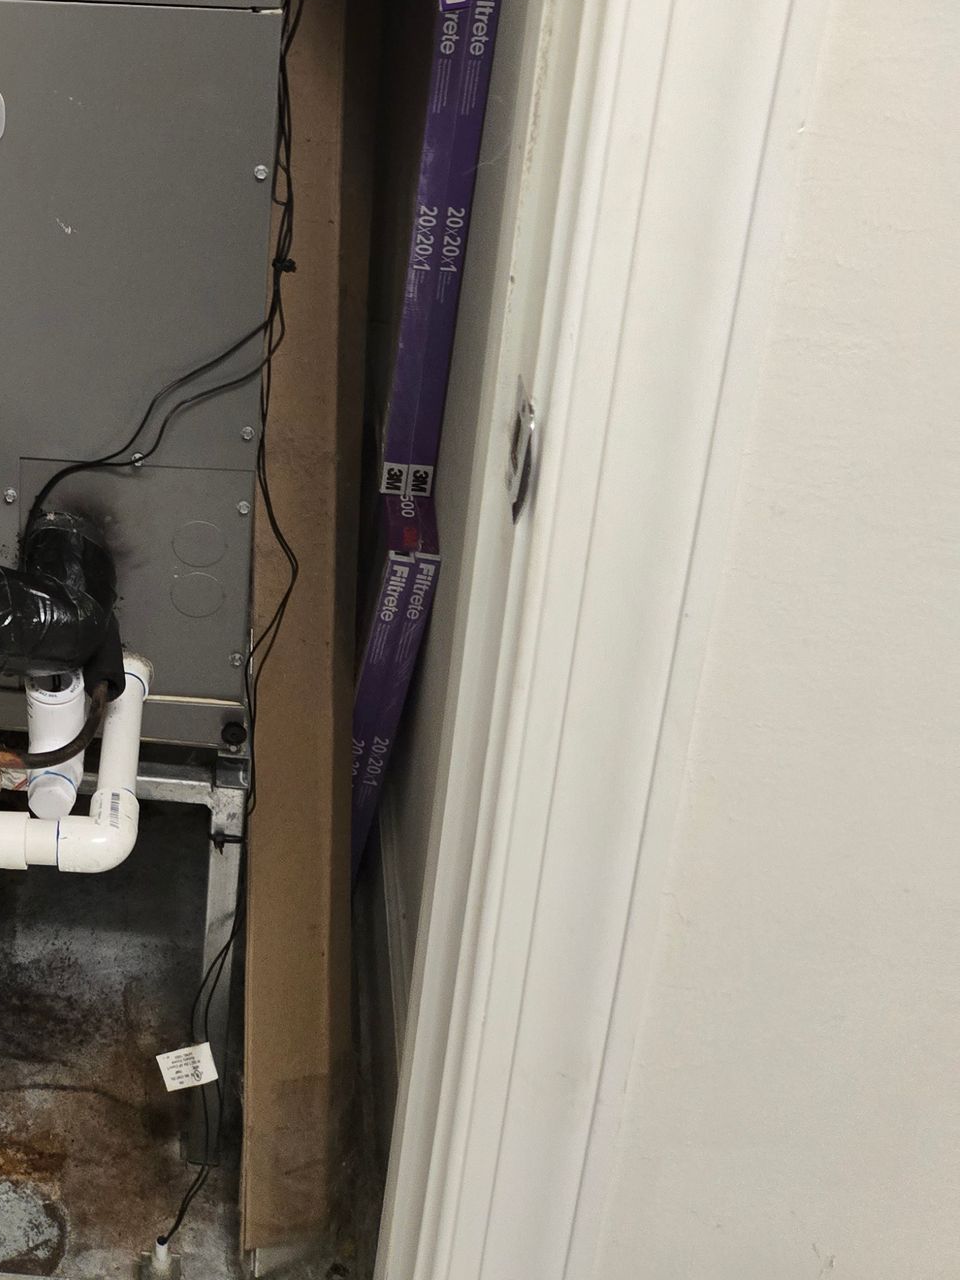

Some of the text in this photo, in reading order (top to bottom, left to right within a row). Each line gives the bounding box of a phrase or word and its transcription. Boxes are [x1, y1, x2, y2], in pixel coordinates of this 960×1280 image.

[413, 205, 439, 272] 20x20x1
[440, 206, 466, 273] 20x20x1
[385, 467, 403, 491] 3M
[411, 469, 428, 494] 3M
[379, 565, 410, 623] Filtrete
[406, 562, 437, 620] Filtrete
